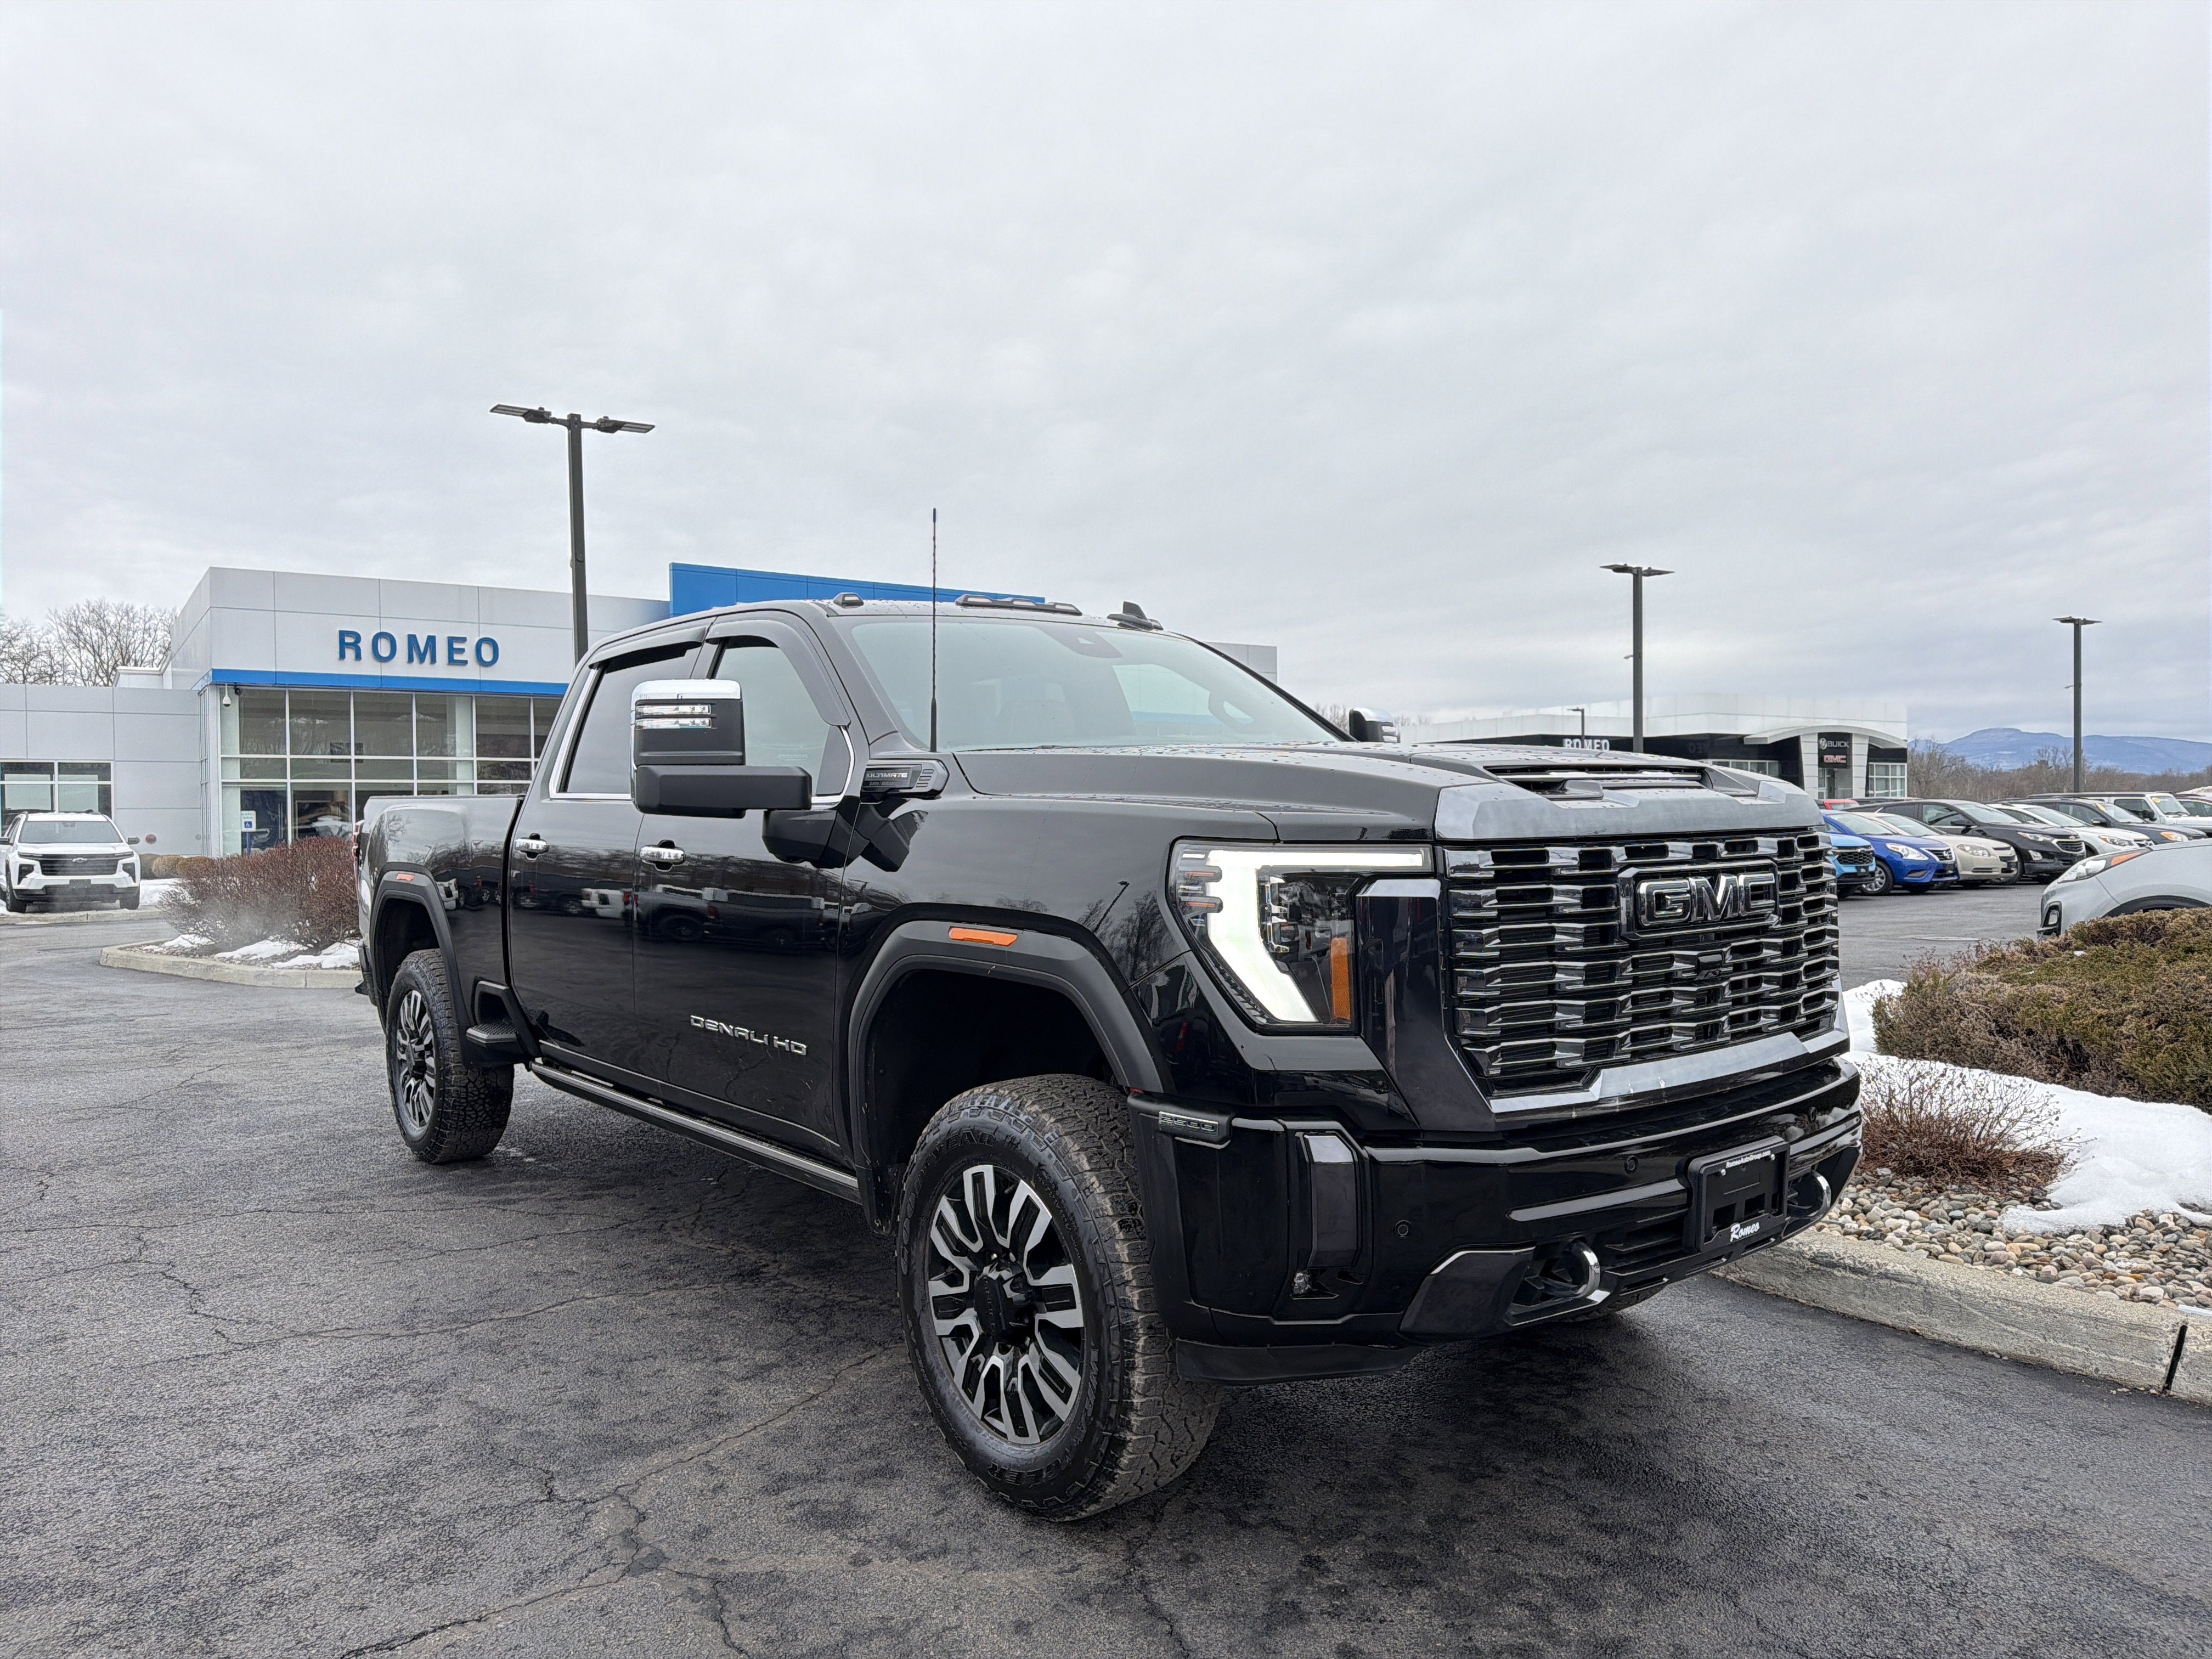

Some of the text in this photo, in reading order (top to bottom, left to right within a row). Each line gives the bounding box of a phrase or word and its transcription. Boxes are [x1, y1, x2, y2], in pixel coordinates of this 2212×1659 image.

[338, 629, 499, 668] ROMEO
[1563, 738, 1610, 752] ROMEO
[1824, 755, 1847, 763] GMC
[1636, 873, 1776, 926] GMC
[690, 1015, 807, 1056] DENALI HD
[1725, 1150, 1771, 1169] RomeoAutoGroup.com
[1730, 1222, 1760, 1243] Romeo
